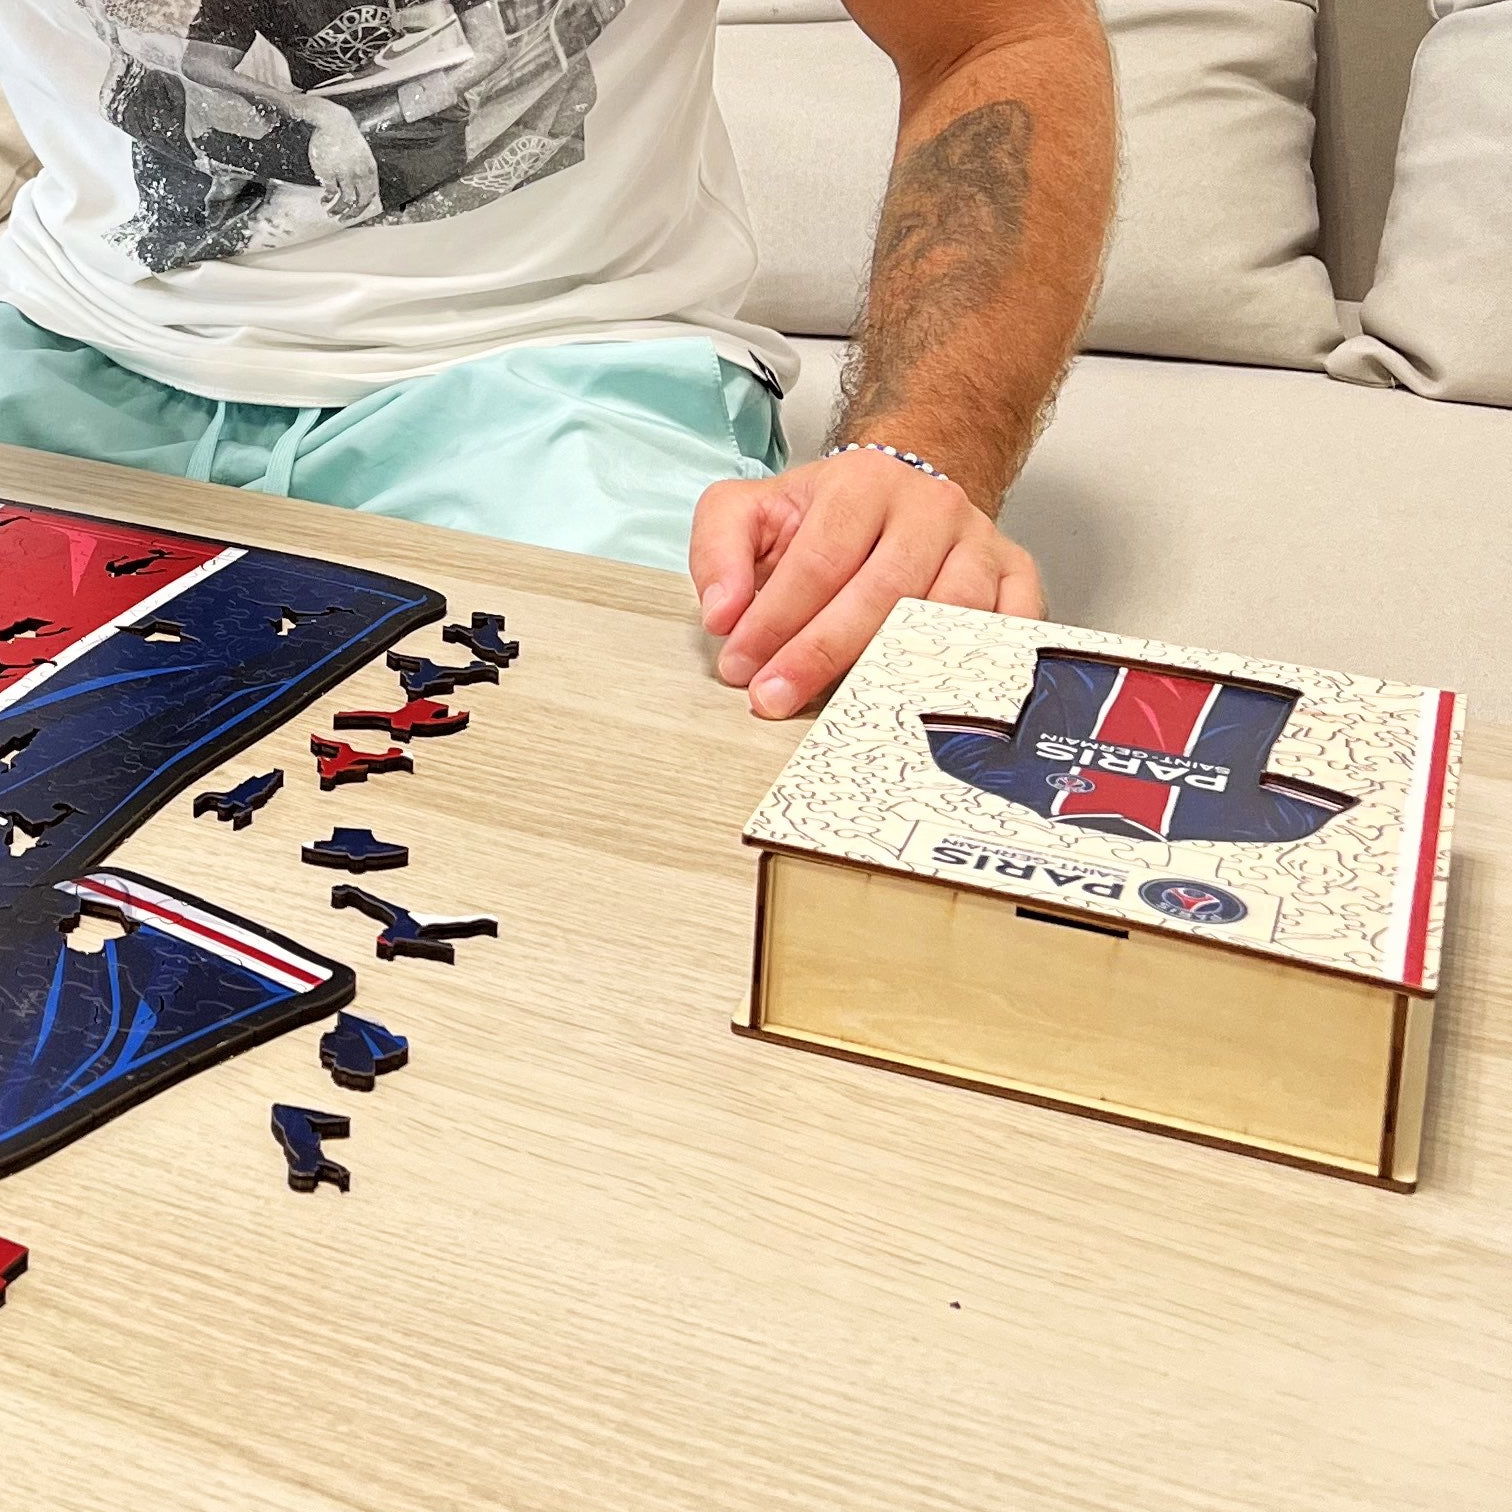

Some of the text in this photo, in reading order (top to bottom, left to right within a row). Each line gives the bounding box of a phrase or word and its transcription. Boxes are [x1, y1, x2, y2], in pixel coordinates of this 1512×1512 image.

[1035, 740, 1229, 793] PARIS
[1039, 732, 1231, 776] SAINT-GERMAIN
[931, 846, 1125, 901] PARIS
